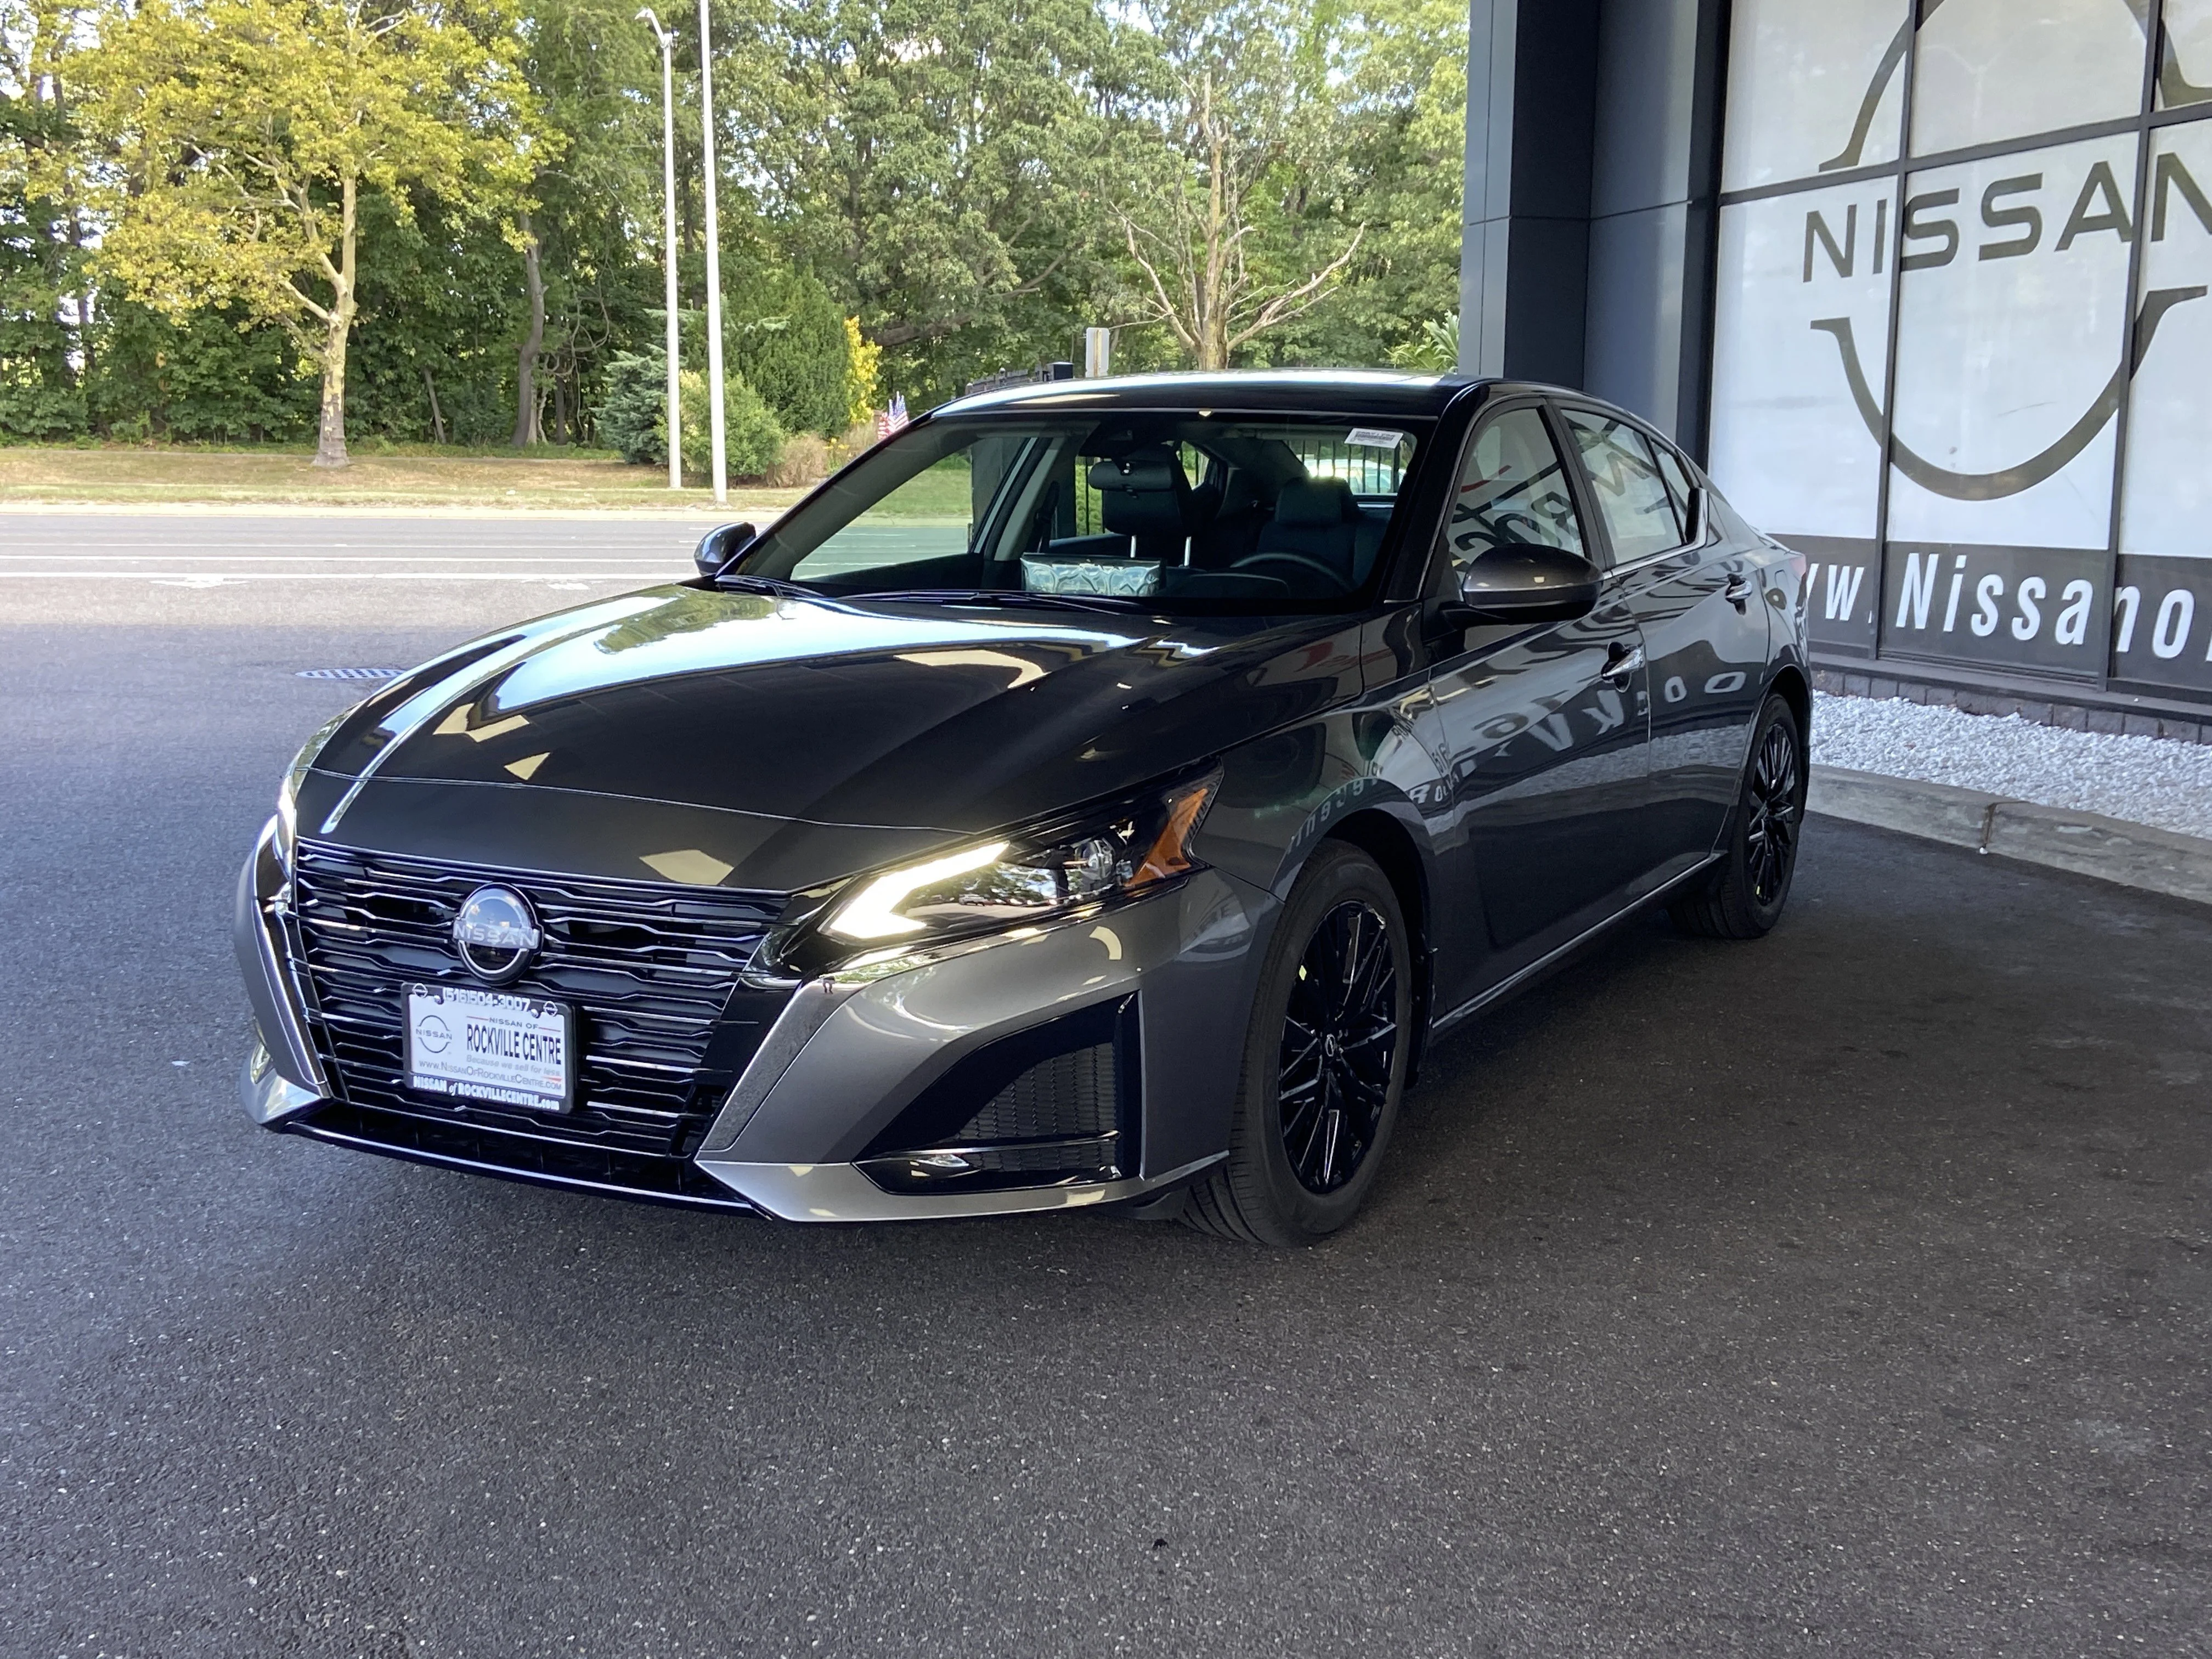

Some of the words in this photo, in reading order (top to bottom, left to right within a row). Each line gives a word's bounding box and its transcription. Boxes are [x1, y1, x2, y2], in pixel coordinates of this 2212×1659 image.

[1803, 152, 2212, 283] NISSAN
[454, 924, 539, 947] NISSAN
[489, 1017, 522, 1028] NISSAN
[415, 1028, 453, 1040] NISSAN
[466, 1024, 520, 1058] ROCKVILLE
[523, 1031, 561, 1065] CENTRE
[466, 1054, 500, 1067] Because
[501, 1061, 512, 1069] we
[515, 1063, 529, 1071] sell
[531, 1064, 542, 1074] for
[413, 1075, 447, 1092] NISSAN
[449, 1082, 458, 1096] of
